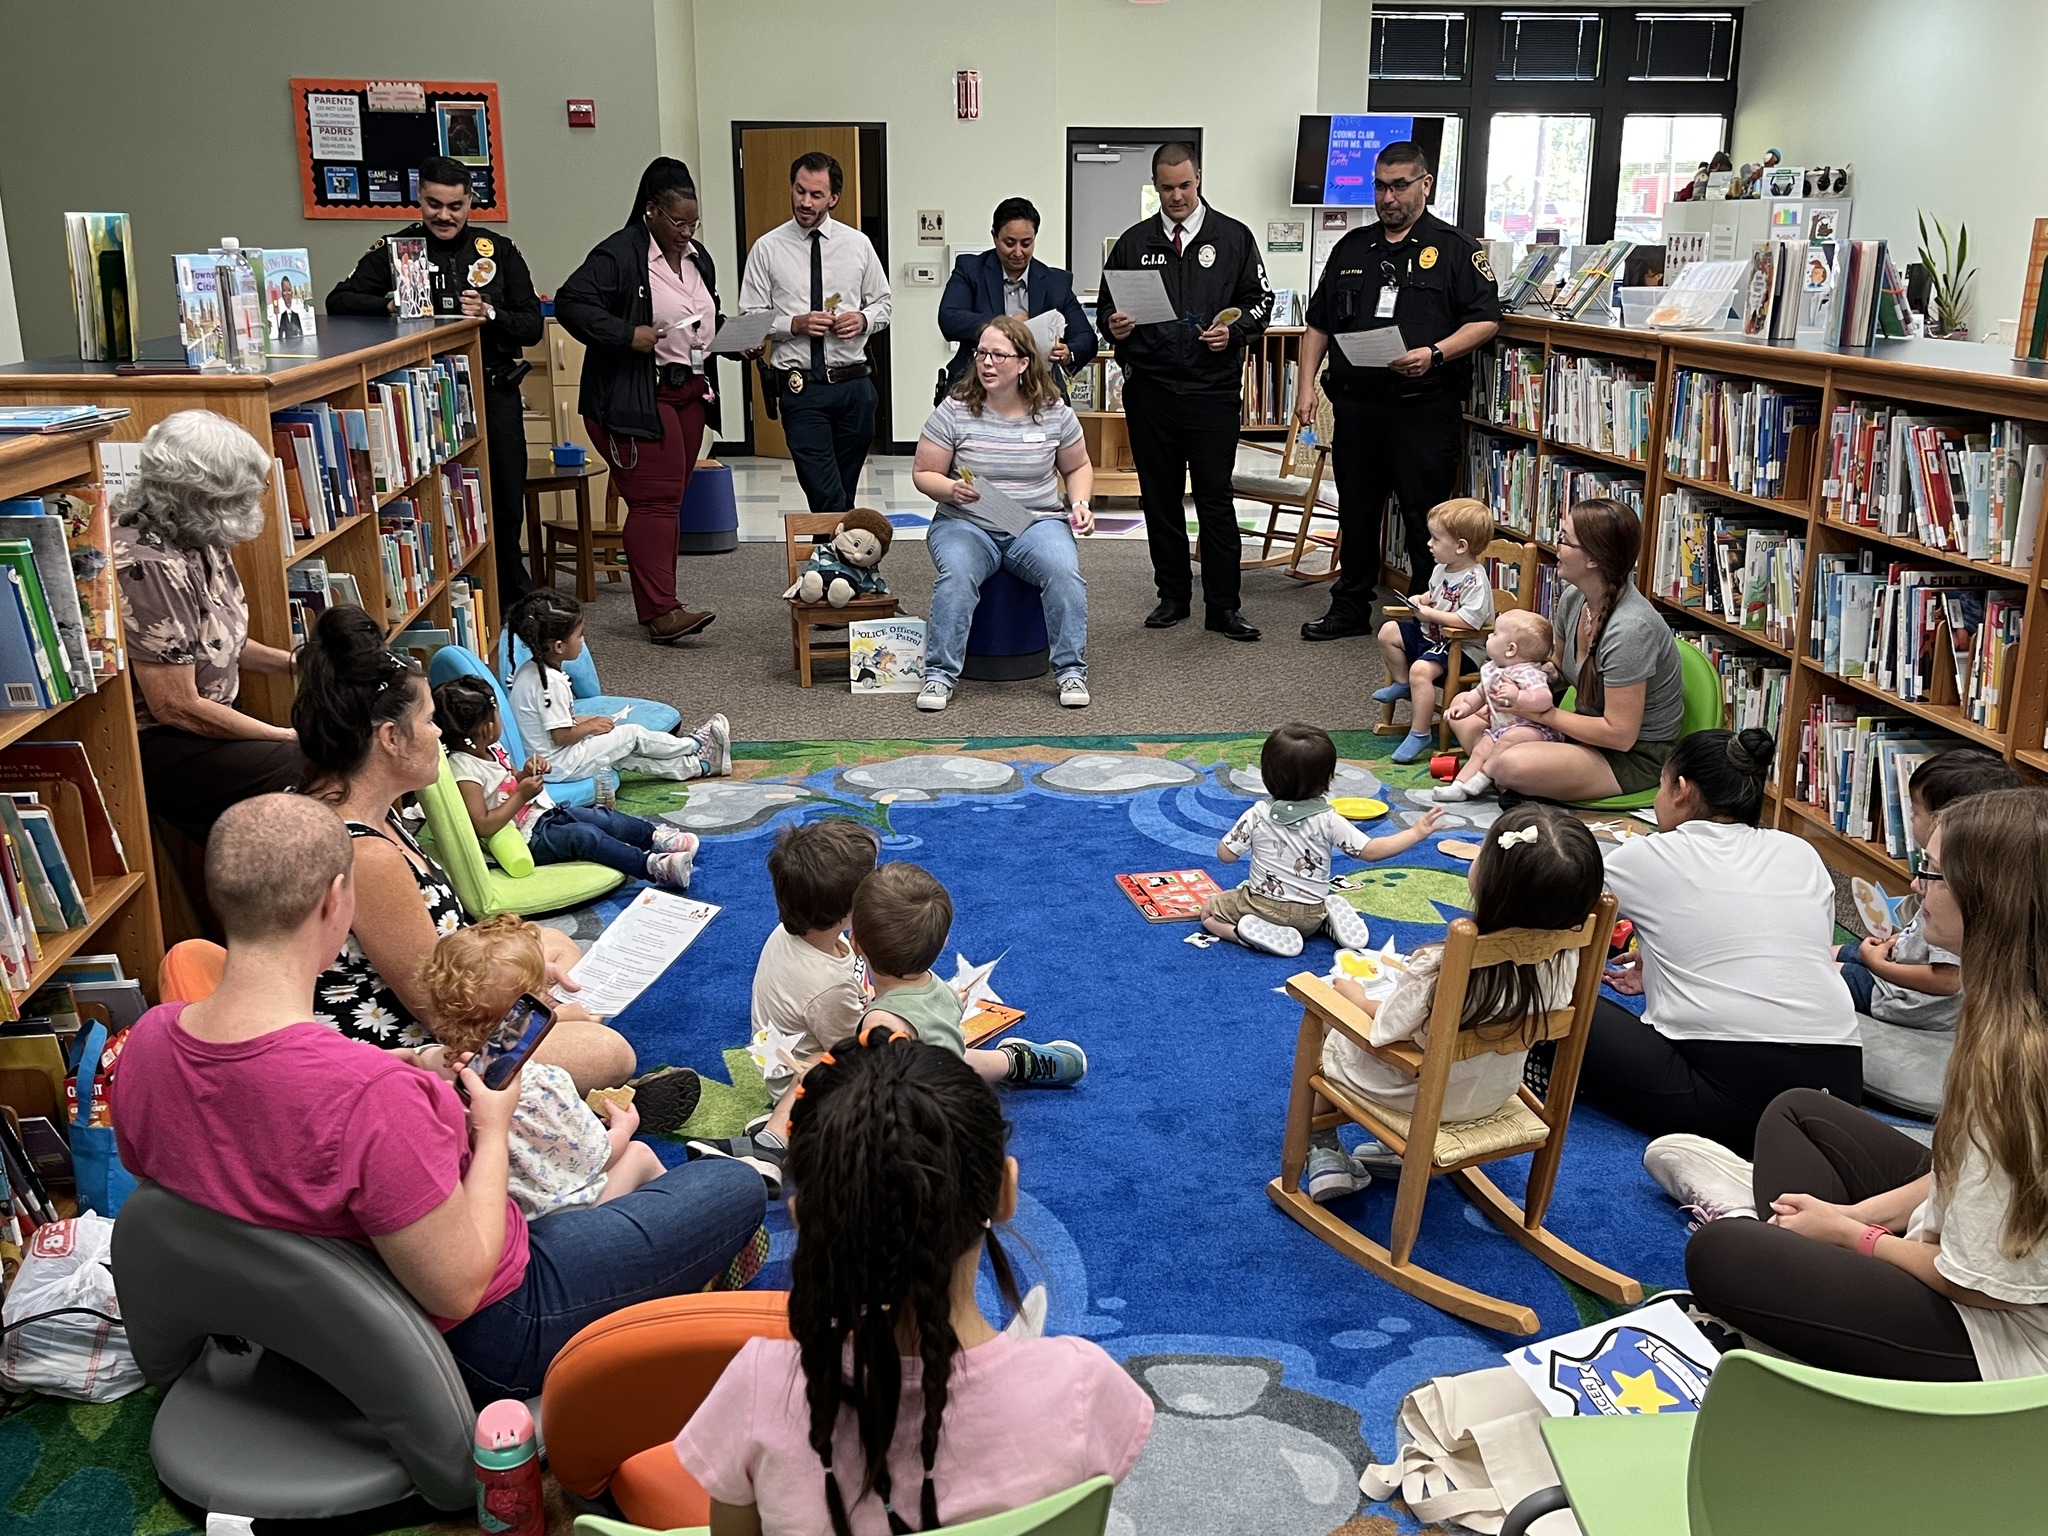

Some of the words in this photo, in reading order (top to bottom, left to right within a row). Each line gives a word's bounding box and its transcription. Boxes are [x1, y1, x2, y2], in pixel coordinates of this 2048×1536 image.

[314, 97, 354, 105] PARENTS
[319, 127, 354, 136] PADRES
[1333, 130, 1356, 139] CODING
[1332, 140, 1348, 148] WITH
[1332, 151, 1347, 160] May
[368, 170, 387, 178] GAME
[1141, 254, 1167, 265] C.I.D.
[191, 270, 214, 279] Towns
[197, 282, 216, 291] Citie
[1071, 392, 1089, 400] RIGHT
[1755, 540, 1779, 552] POPP
[1918, 576, 1925, 585] A
[889, 626, 924, 639] Officers
[895, 633, 921, 647] Patrol
